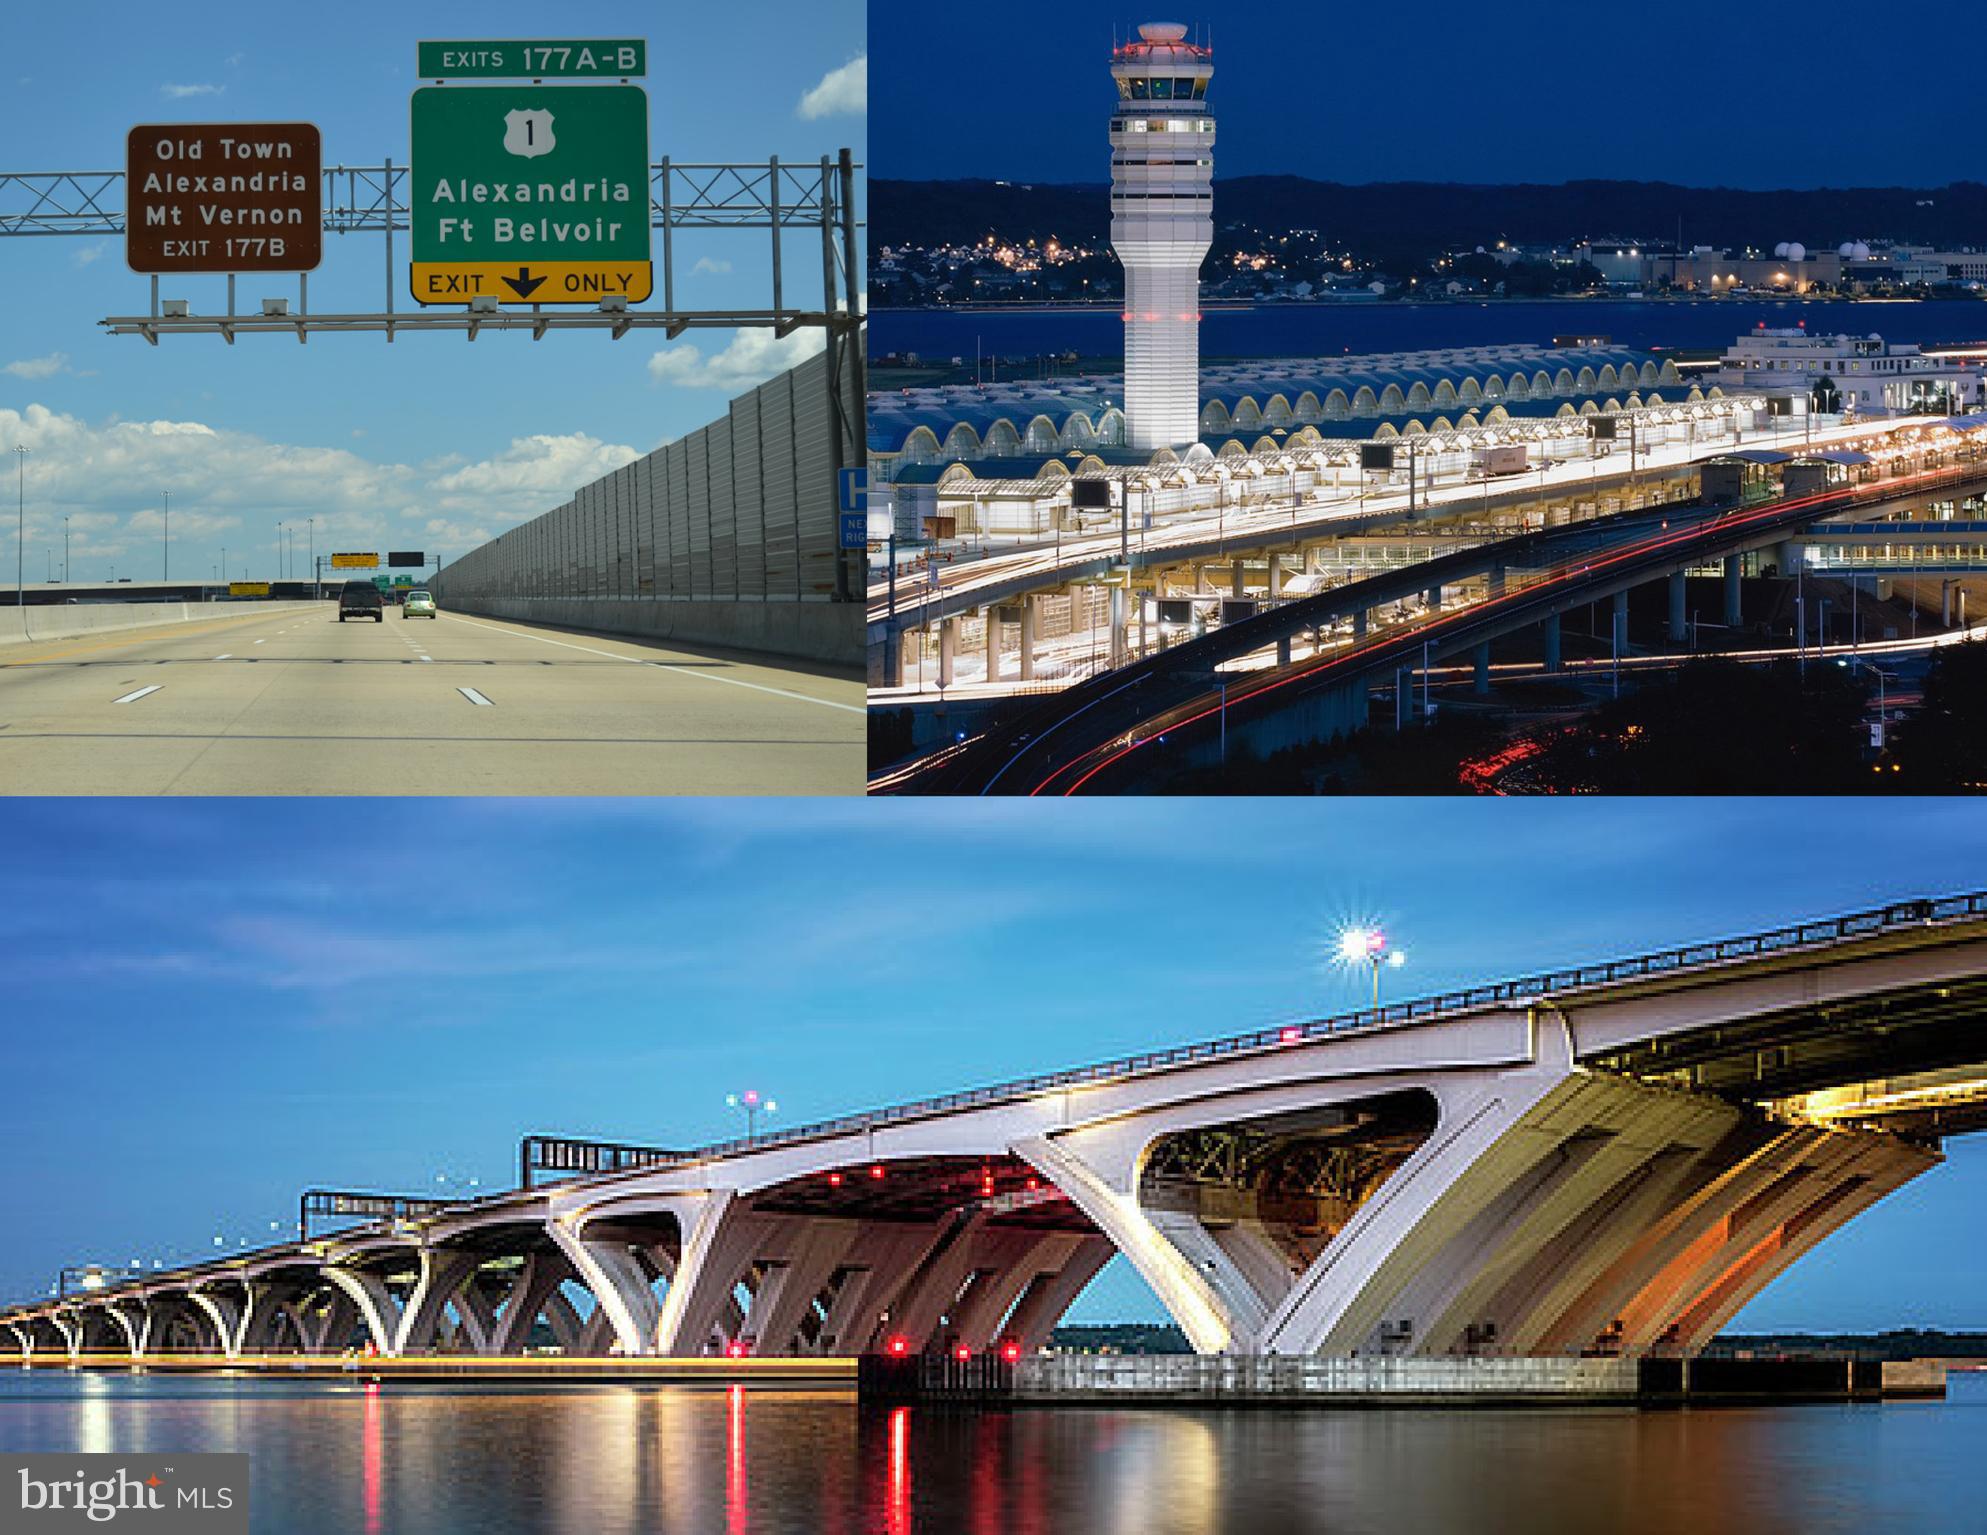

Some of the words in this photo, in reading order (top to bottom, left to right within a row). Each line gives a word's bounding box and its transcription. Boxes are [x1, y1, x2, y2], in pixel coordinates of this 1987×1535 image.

[443, 51, 504, 68] EXITS
[523, 47, 637, 70] 177A-B
[525, 119, 534, 146] 1
[156, 139, 202, 160] Old
[220, 138, 292, 160] Town
[143, 171, 306, 193] Alexandria
[432, 178, 630, 203] Alexandria
[146, 205, 182, 226] Mt
[200, 204, 302, 225] Vernon
[439, 218, 473, 243] Ft
[494, 217, 622, 242] Belvoir
[163, 240, 210, 256] EXIT
[225, 238, 285, 257] 177B
[428, 275, 484, 293] EXIT
[564, 273, 633, 292] ONLY
